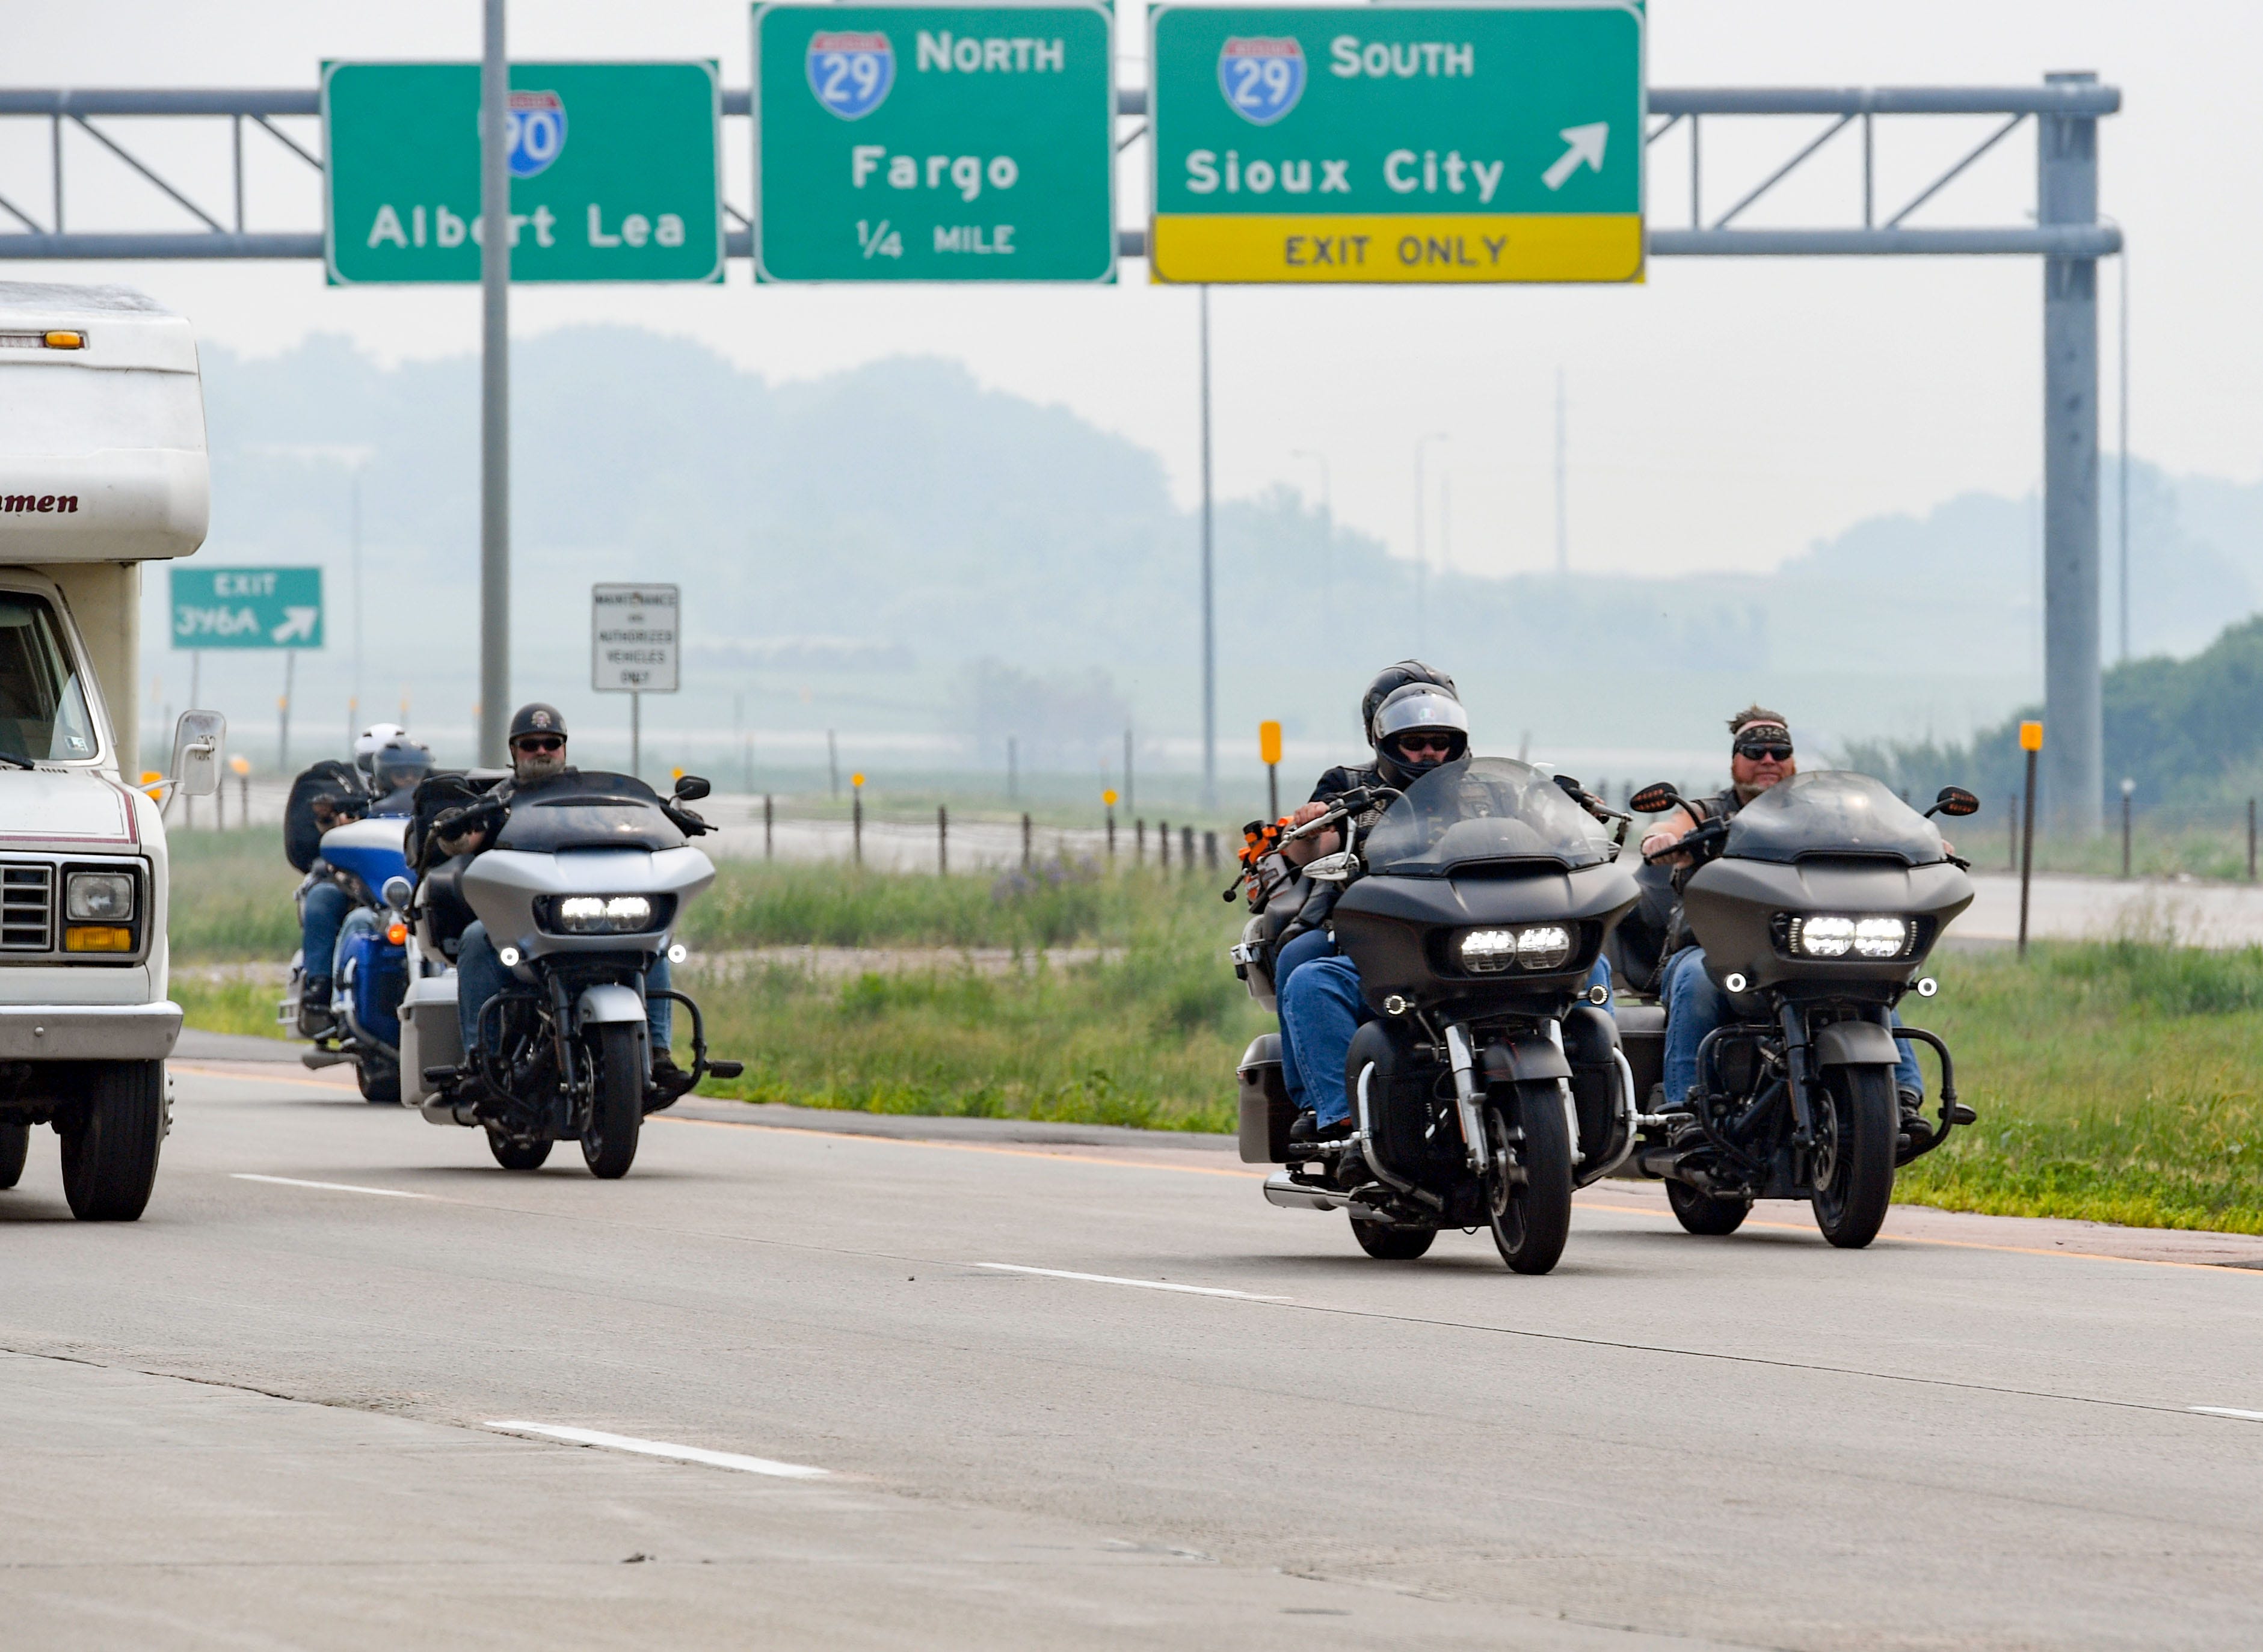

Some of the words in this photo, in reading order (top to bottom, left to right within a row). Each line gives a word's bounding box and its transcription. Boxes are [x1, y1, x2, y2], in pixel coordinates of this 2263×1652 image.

[916, 31, 1065, 73] NORTH
[1329, 35, 1474, 78] SOUTH
[822, 53, 879, 102] 29
[1233, 57, 1291, 107] 29
[852, 146, 1019, 201] Fargo
[1186, 150, 1351, 193] Sioux
[1383, 149, 1504, 203] City
[587, 203, 686, 247] Lea
[933, 225, 1015, 254] MILE
[1285, 236, 1370, 266] EXIT
[1397, 236, 1507, 266] ONLY
[214, 573, 277, 597] EXIT
